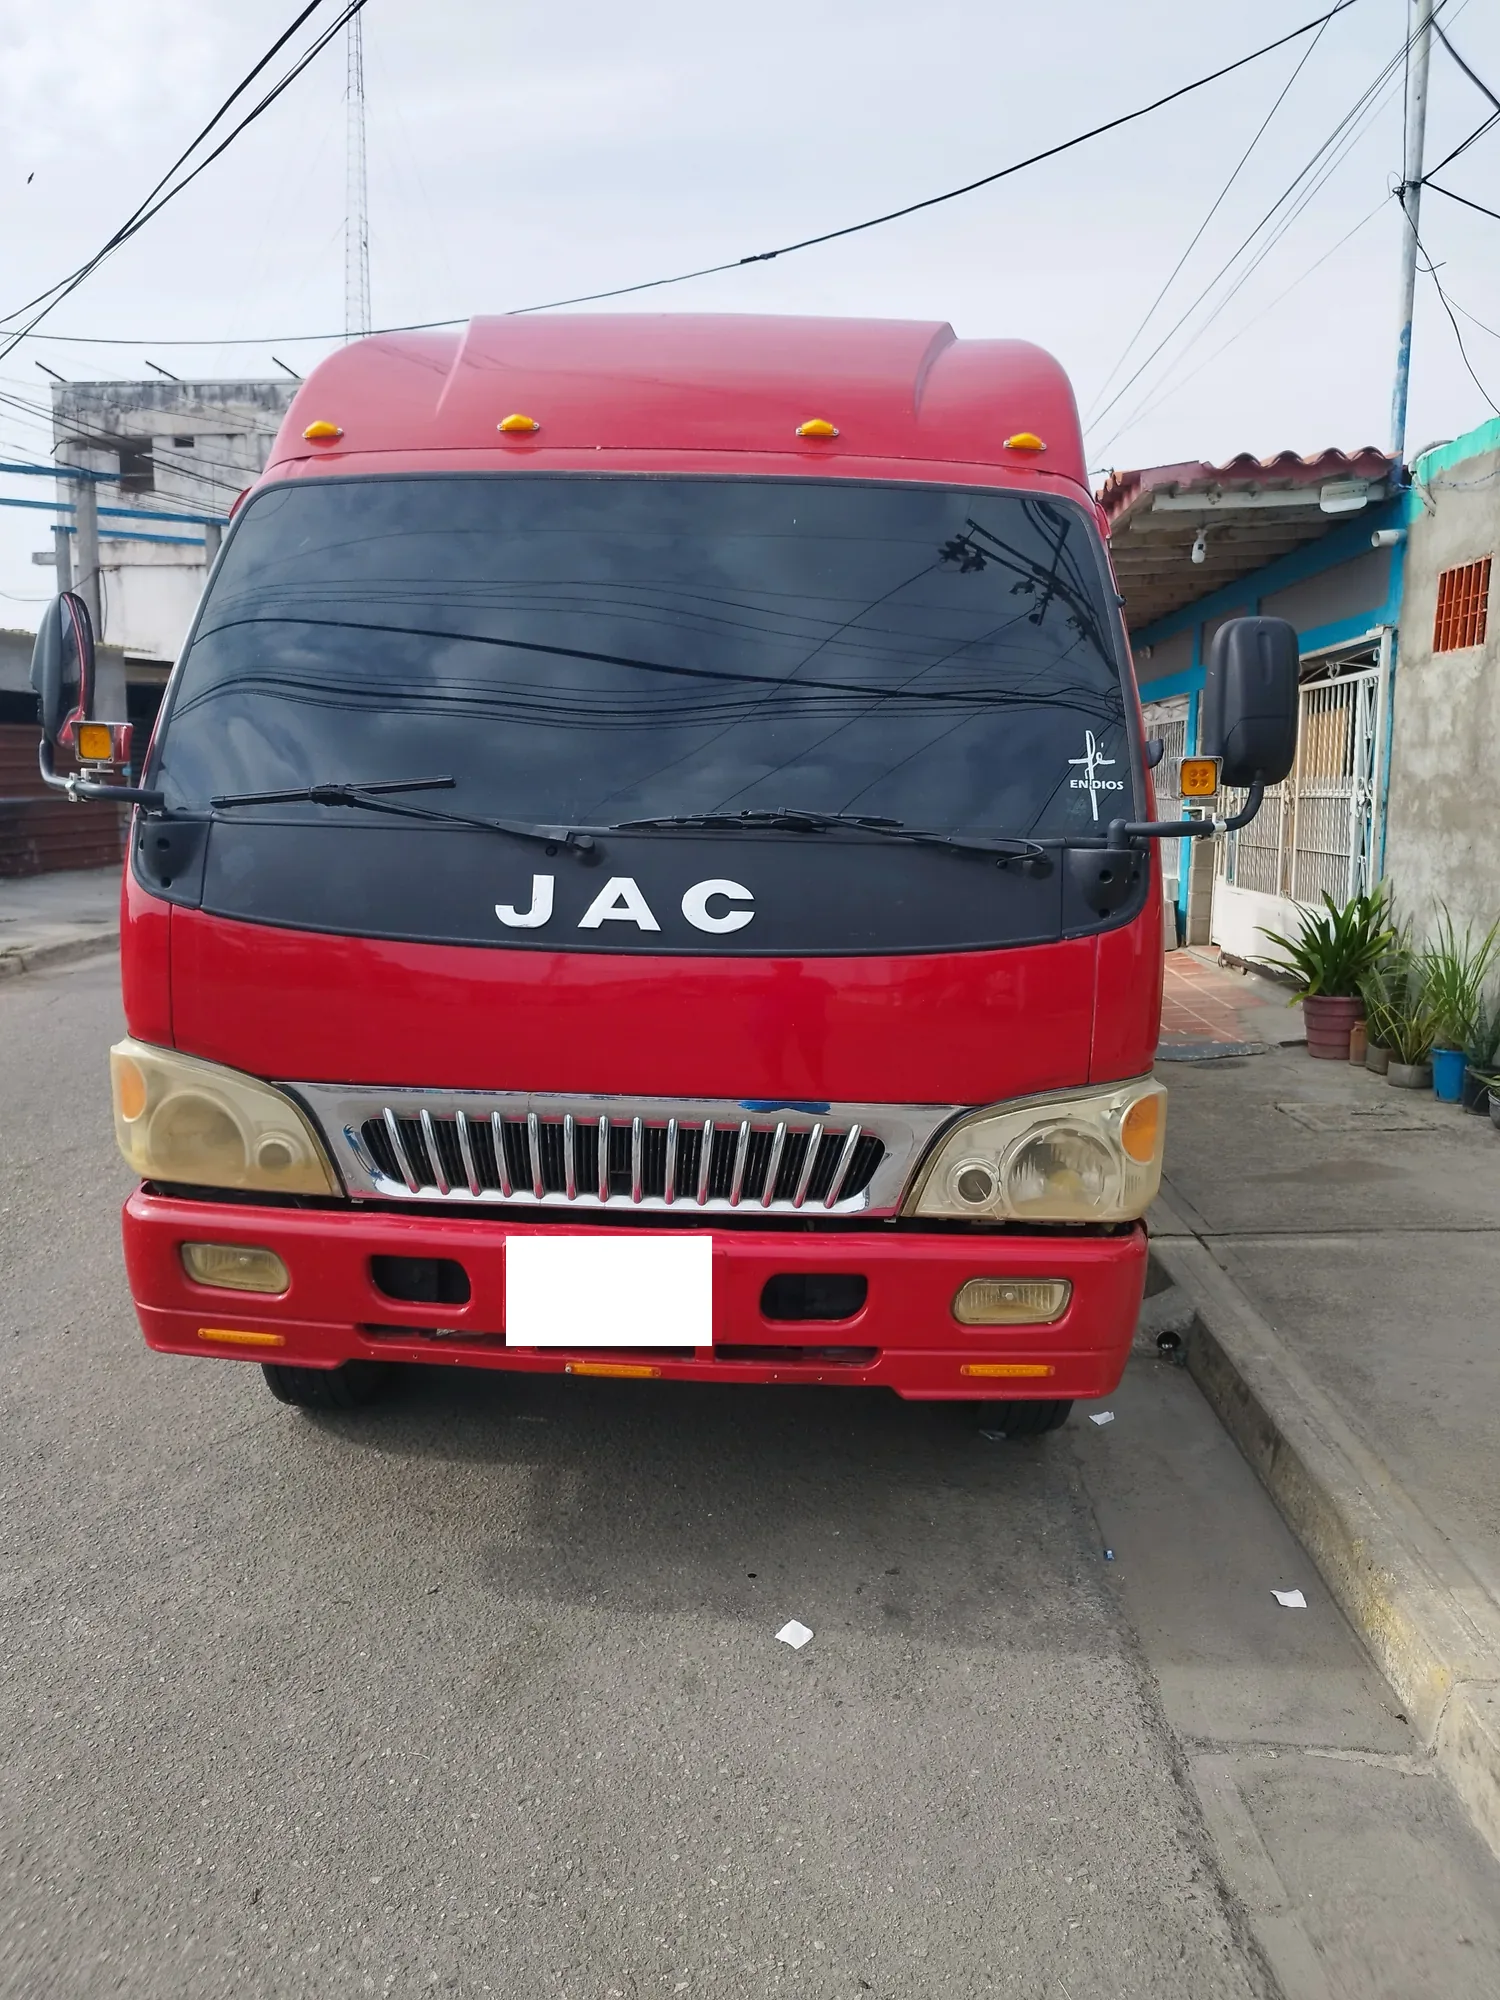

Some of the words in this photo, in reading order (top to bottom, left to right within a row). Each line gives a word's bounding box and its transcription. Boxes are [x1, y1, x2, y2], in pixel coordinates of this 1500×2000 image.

[1070, 780, 1089, 789] EN
[1092, 781, 1124, 790] DIOS
[495, 874, 755, 934] JAC
